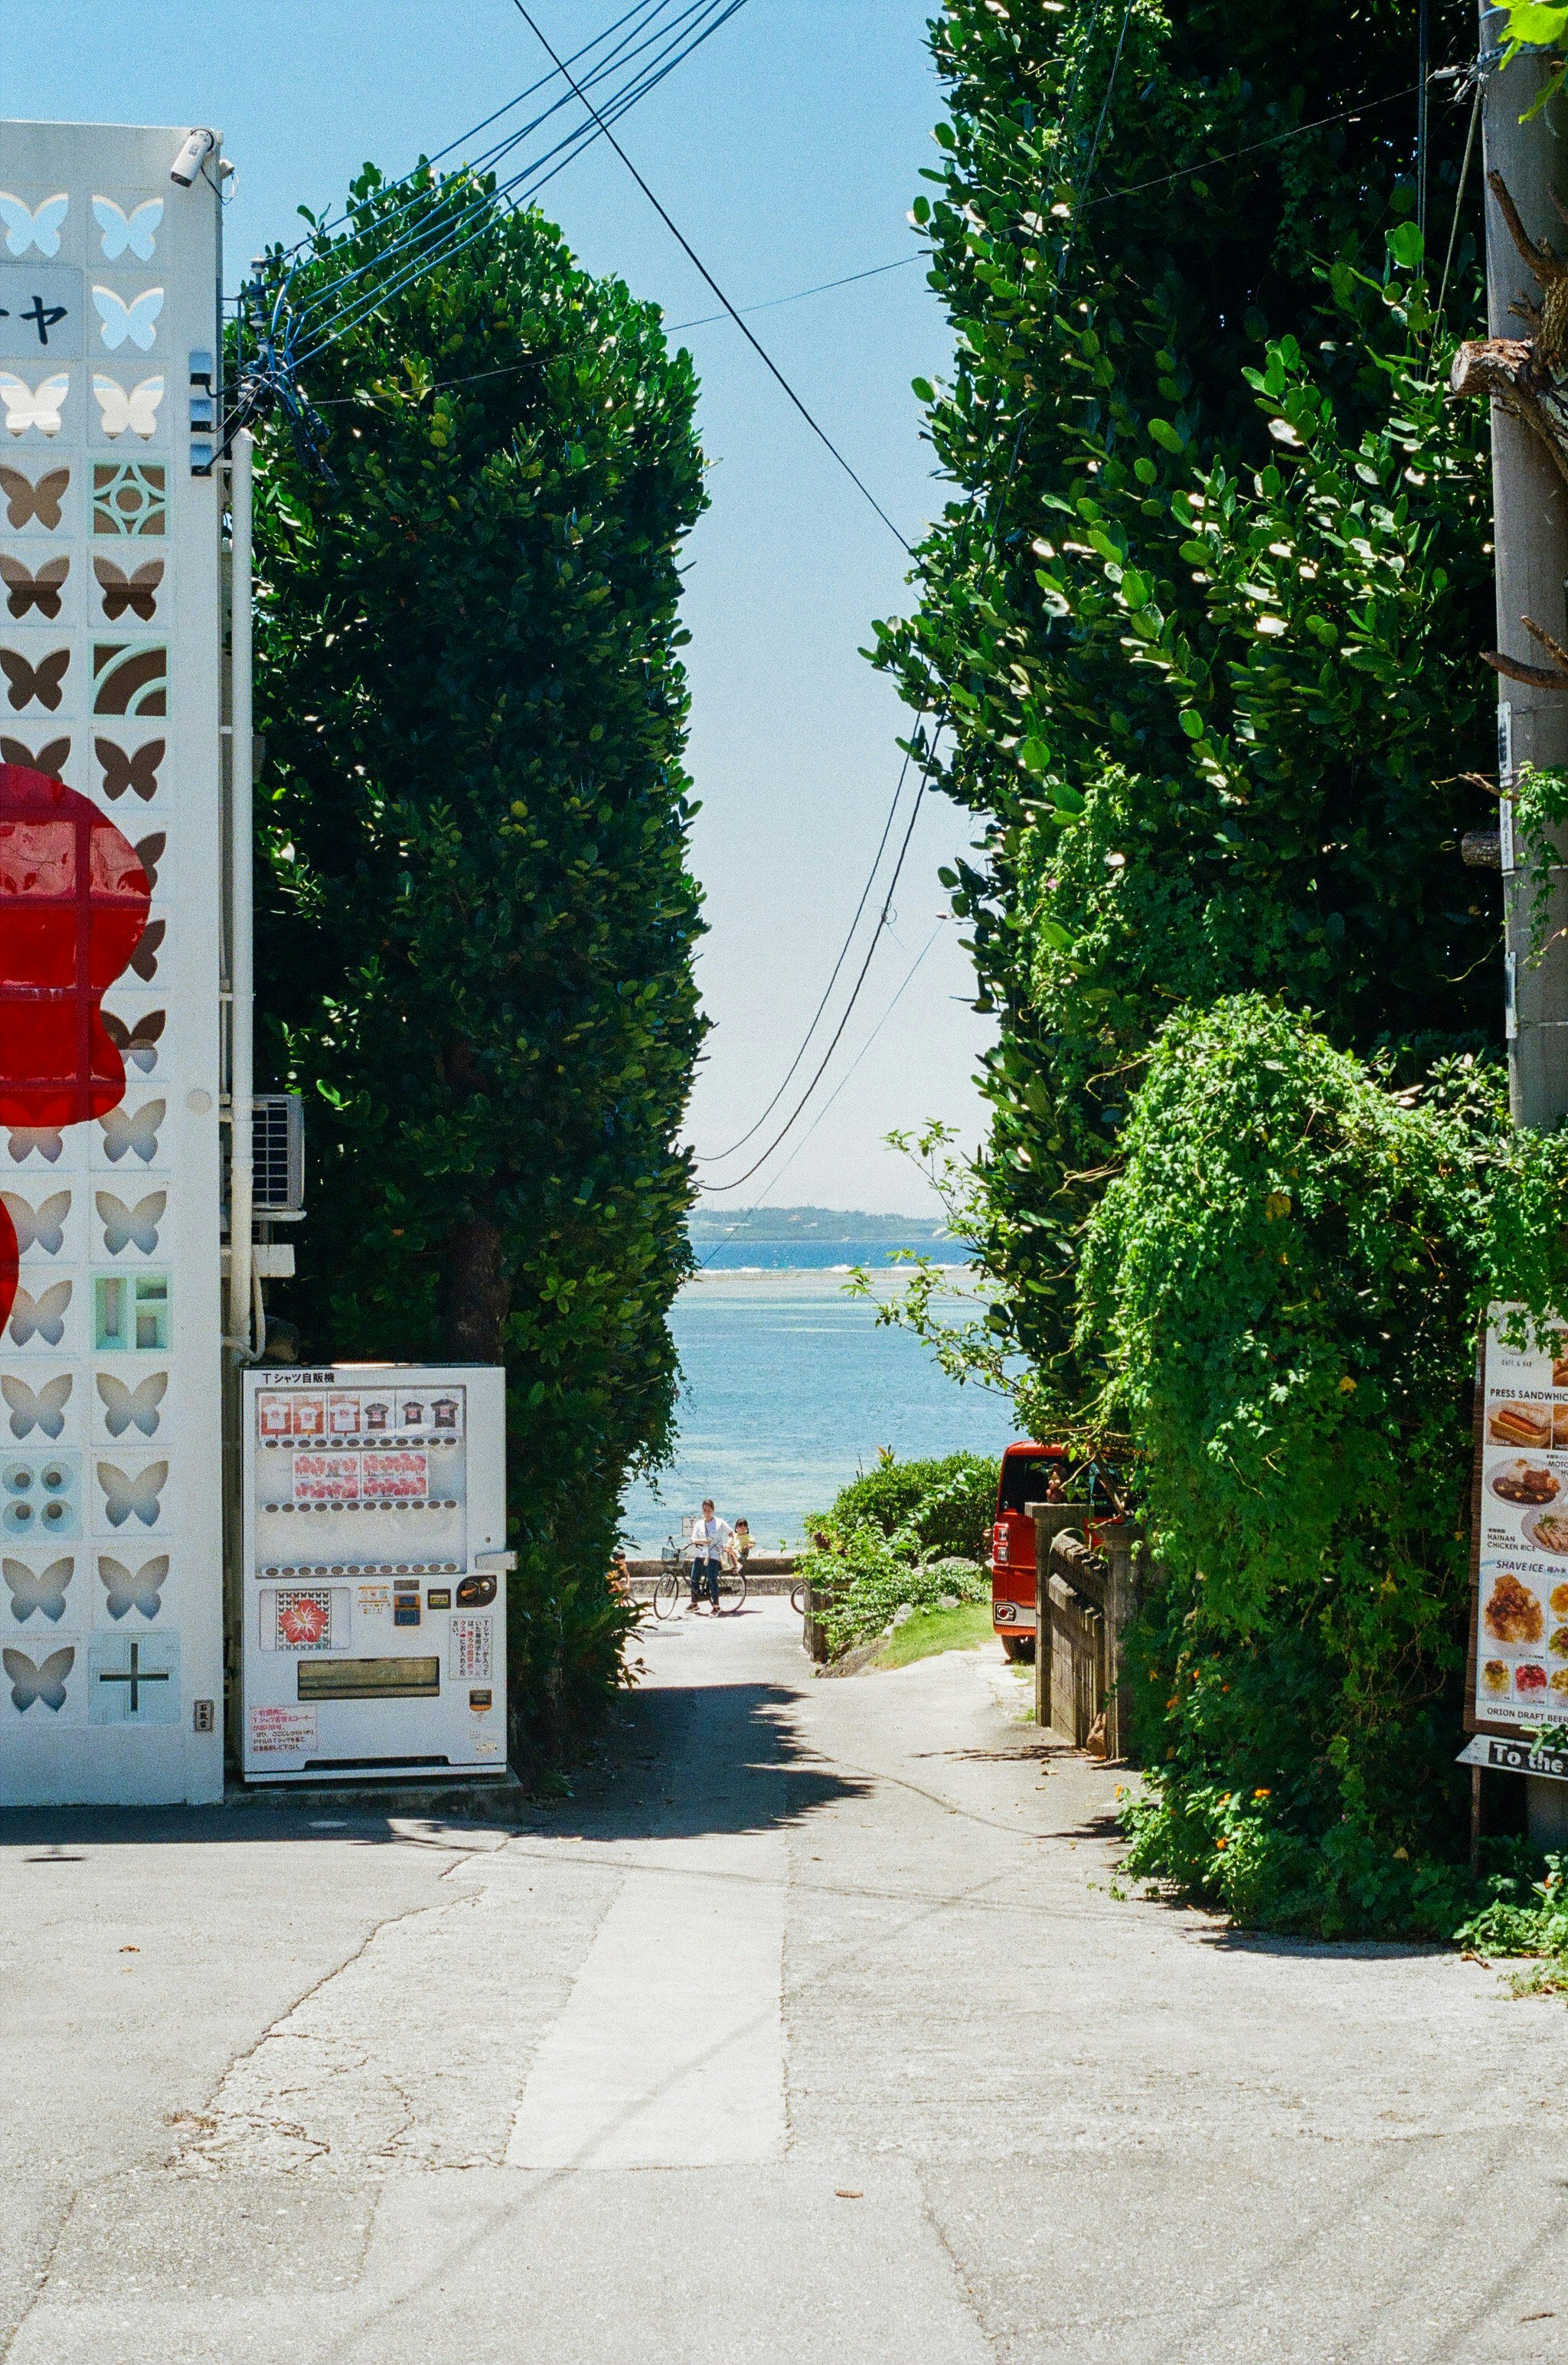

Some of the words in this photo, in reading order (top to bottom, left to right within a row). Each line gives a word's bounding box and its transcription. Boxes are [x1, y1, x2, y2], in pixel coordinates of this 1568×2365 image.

[0, 296, 67, 345] ヤ
[262, 1373, 335, 1383] Tシャツ自販機
[1490, 1388, 1515, 1399] PRESS
[1487, 1534, 1515, 1542] HAINAN
[1487, 1541, 1519, 1550] CHICKEN
[1496, 1560, 1527, 1570] SHAVE
[1529, 1563, 1544, 1573] ICE
[1487, 1707, 1515, 1717] ORION
[1517, 1711, 1544, 1721] DRAFT
[1547, 1714, 1568, 1723] BEER
[1493, 1743, 1521, 1766] To
[1527, 1750, 1564, 1773] the
